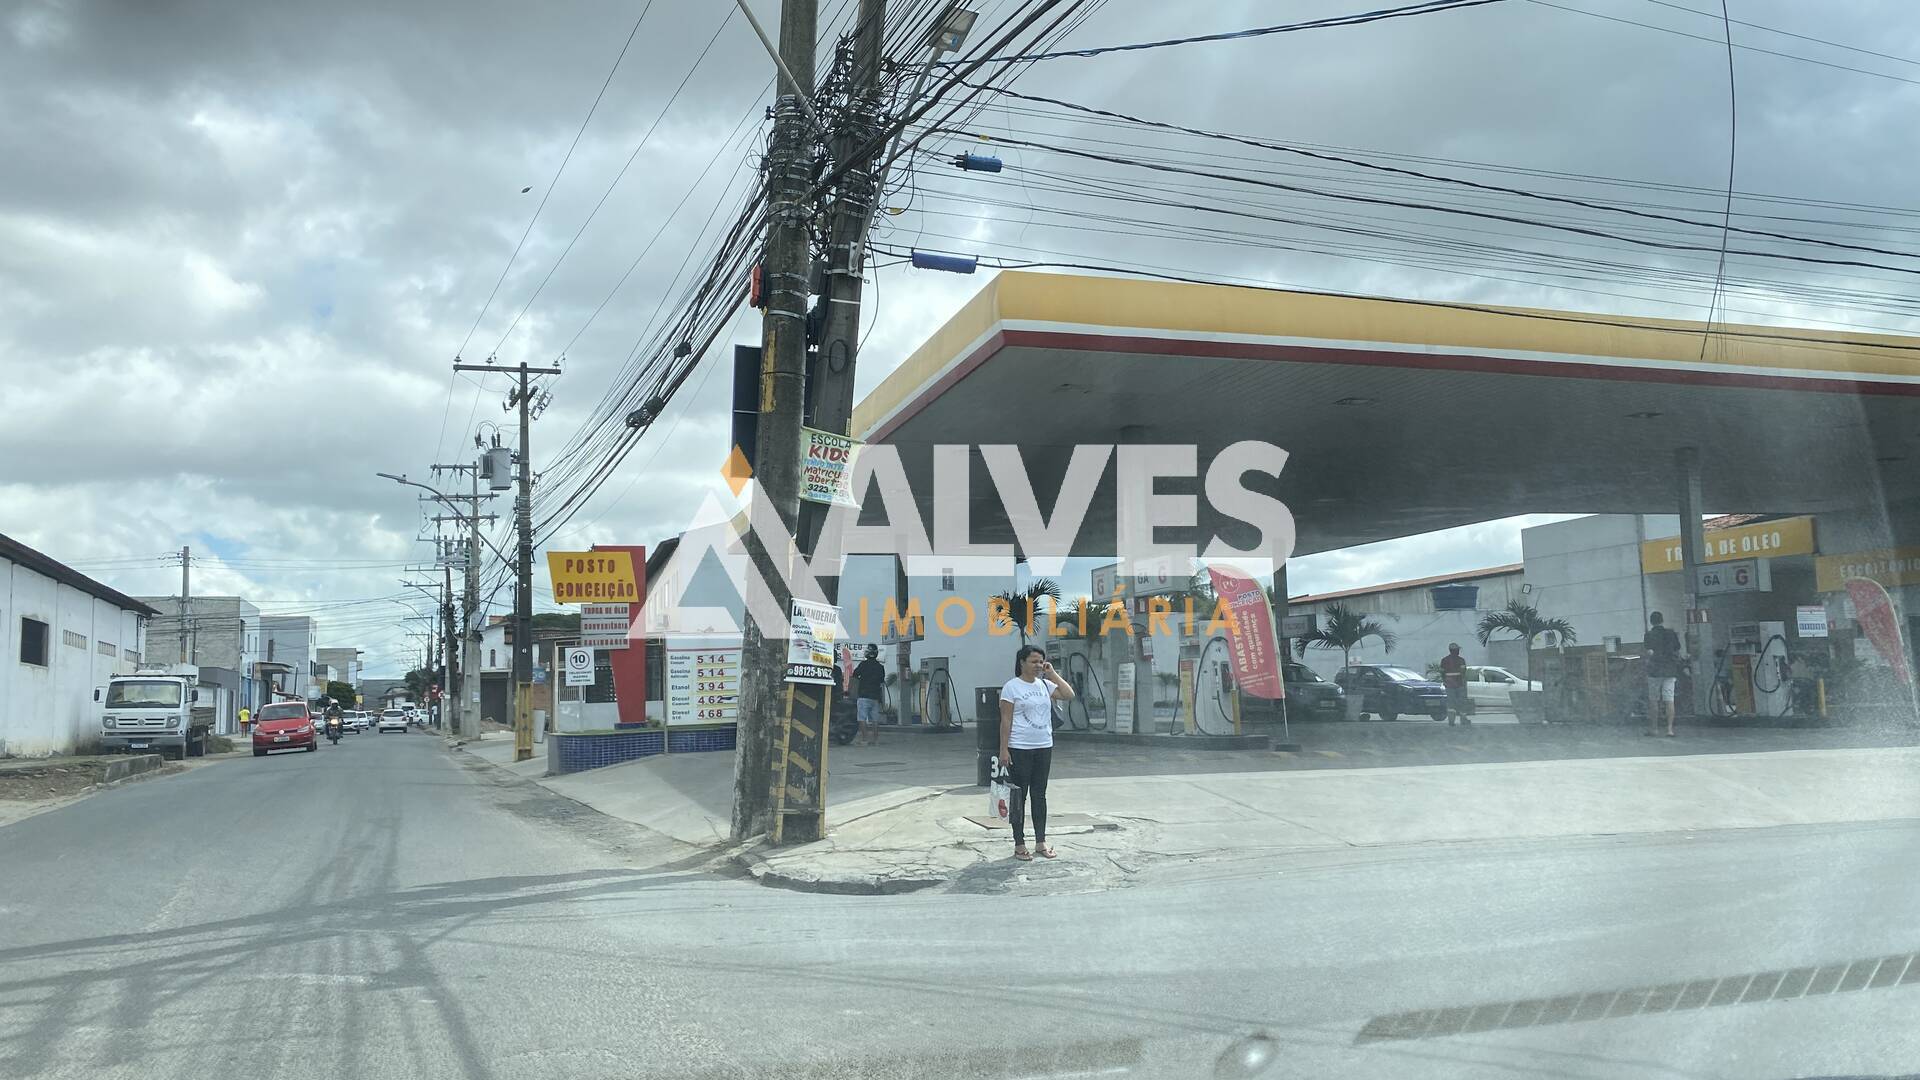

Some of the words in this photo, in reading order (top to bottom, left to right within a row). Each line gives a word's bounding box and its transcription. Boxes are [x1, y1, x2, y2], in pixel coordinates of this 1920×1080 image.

[811, 434, 851, 448] ESCOLA
[1665, 542, 1713, 562] TRA
[1719, 539, 1737, 555] DE
[565, 559, 616, 574] POSTO
[1703, 575, 1721, 586] GA
[1736, 569, 1749, 586] G
[556, 579, 634, 600] CONCEIÇÃO
[572, 654, 586, 664] 10
